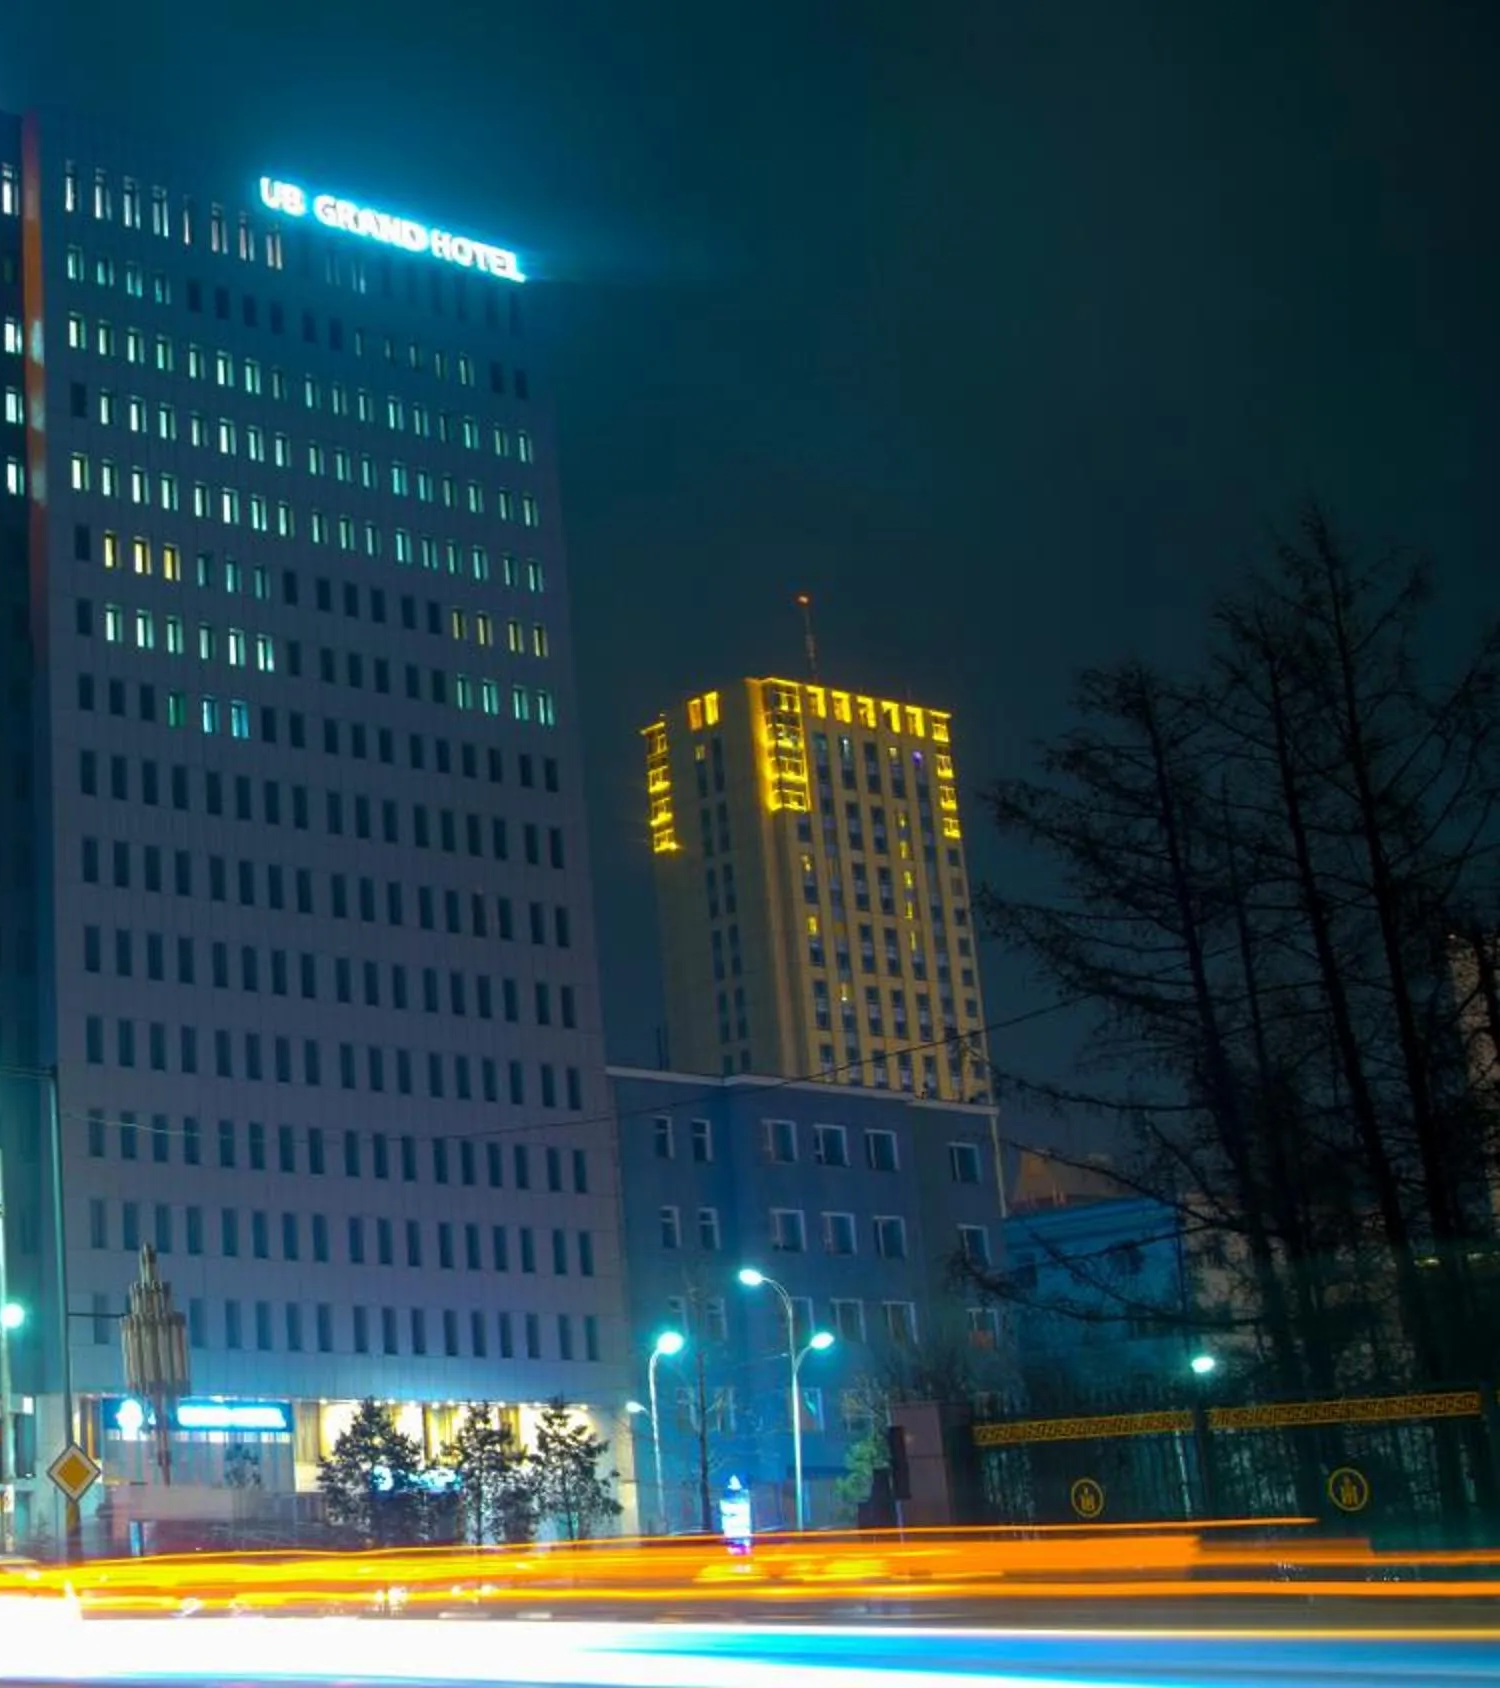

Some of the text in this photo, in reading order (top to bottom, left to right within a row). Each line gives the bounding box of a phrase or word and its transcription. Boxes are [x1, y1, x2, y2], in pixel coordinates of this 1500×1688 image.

[260, 176, 526, 283] UB GRAND HOTEL
